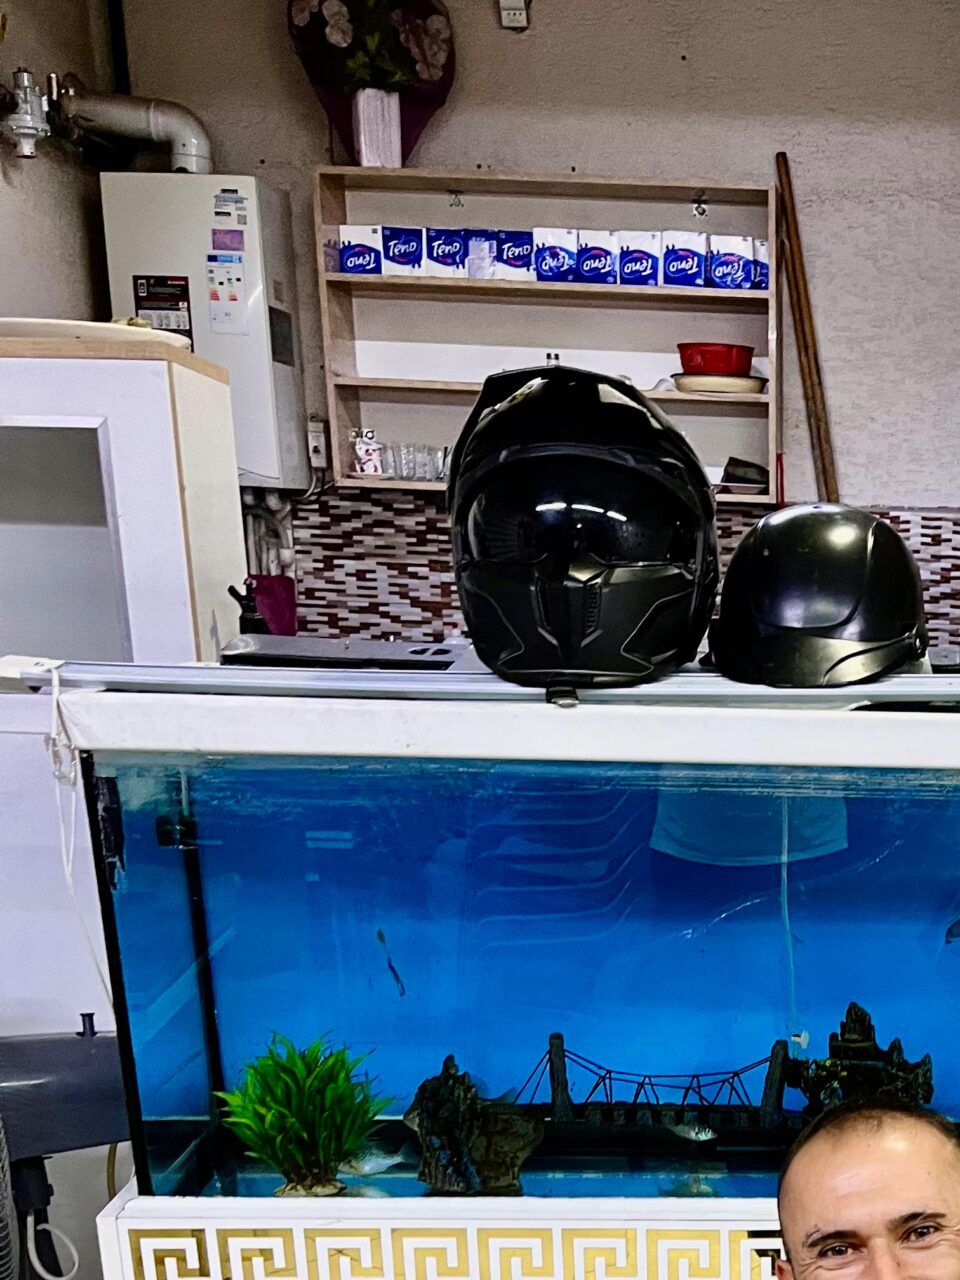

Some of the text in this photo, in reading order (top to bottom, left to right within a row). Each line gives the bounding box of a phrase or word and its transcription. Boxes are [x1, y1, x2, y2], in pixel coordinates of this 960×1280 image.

[387, 239, 417, 256] Teno
[431, 240, 461, 257] Teno
[502, 242, 530, 259] Teno
[347, 252, 377, 269] Teno
[624, 258, 653, 275] Teno
[670, 256, 700, 275] Teno
